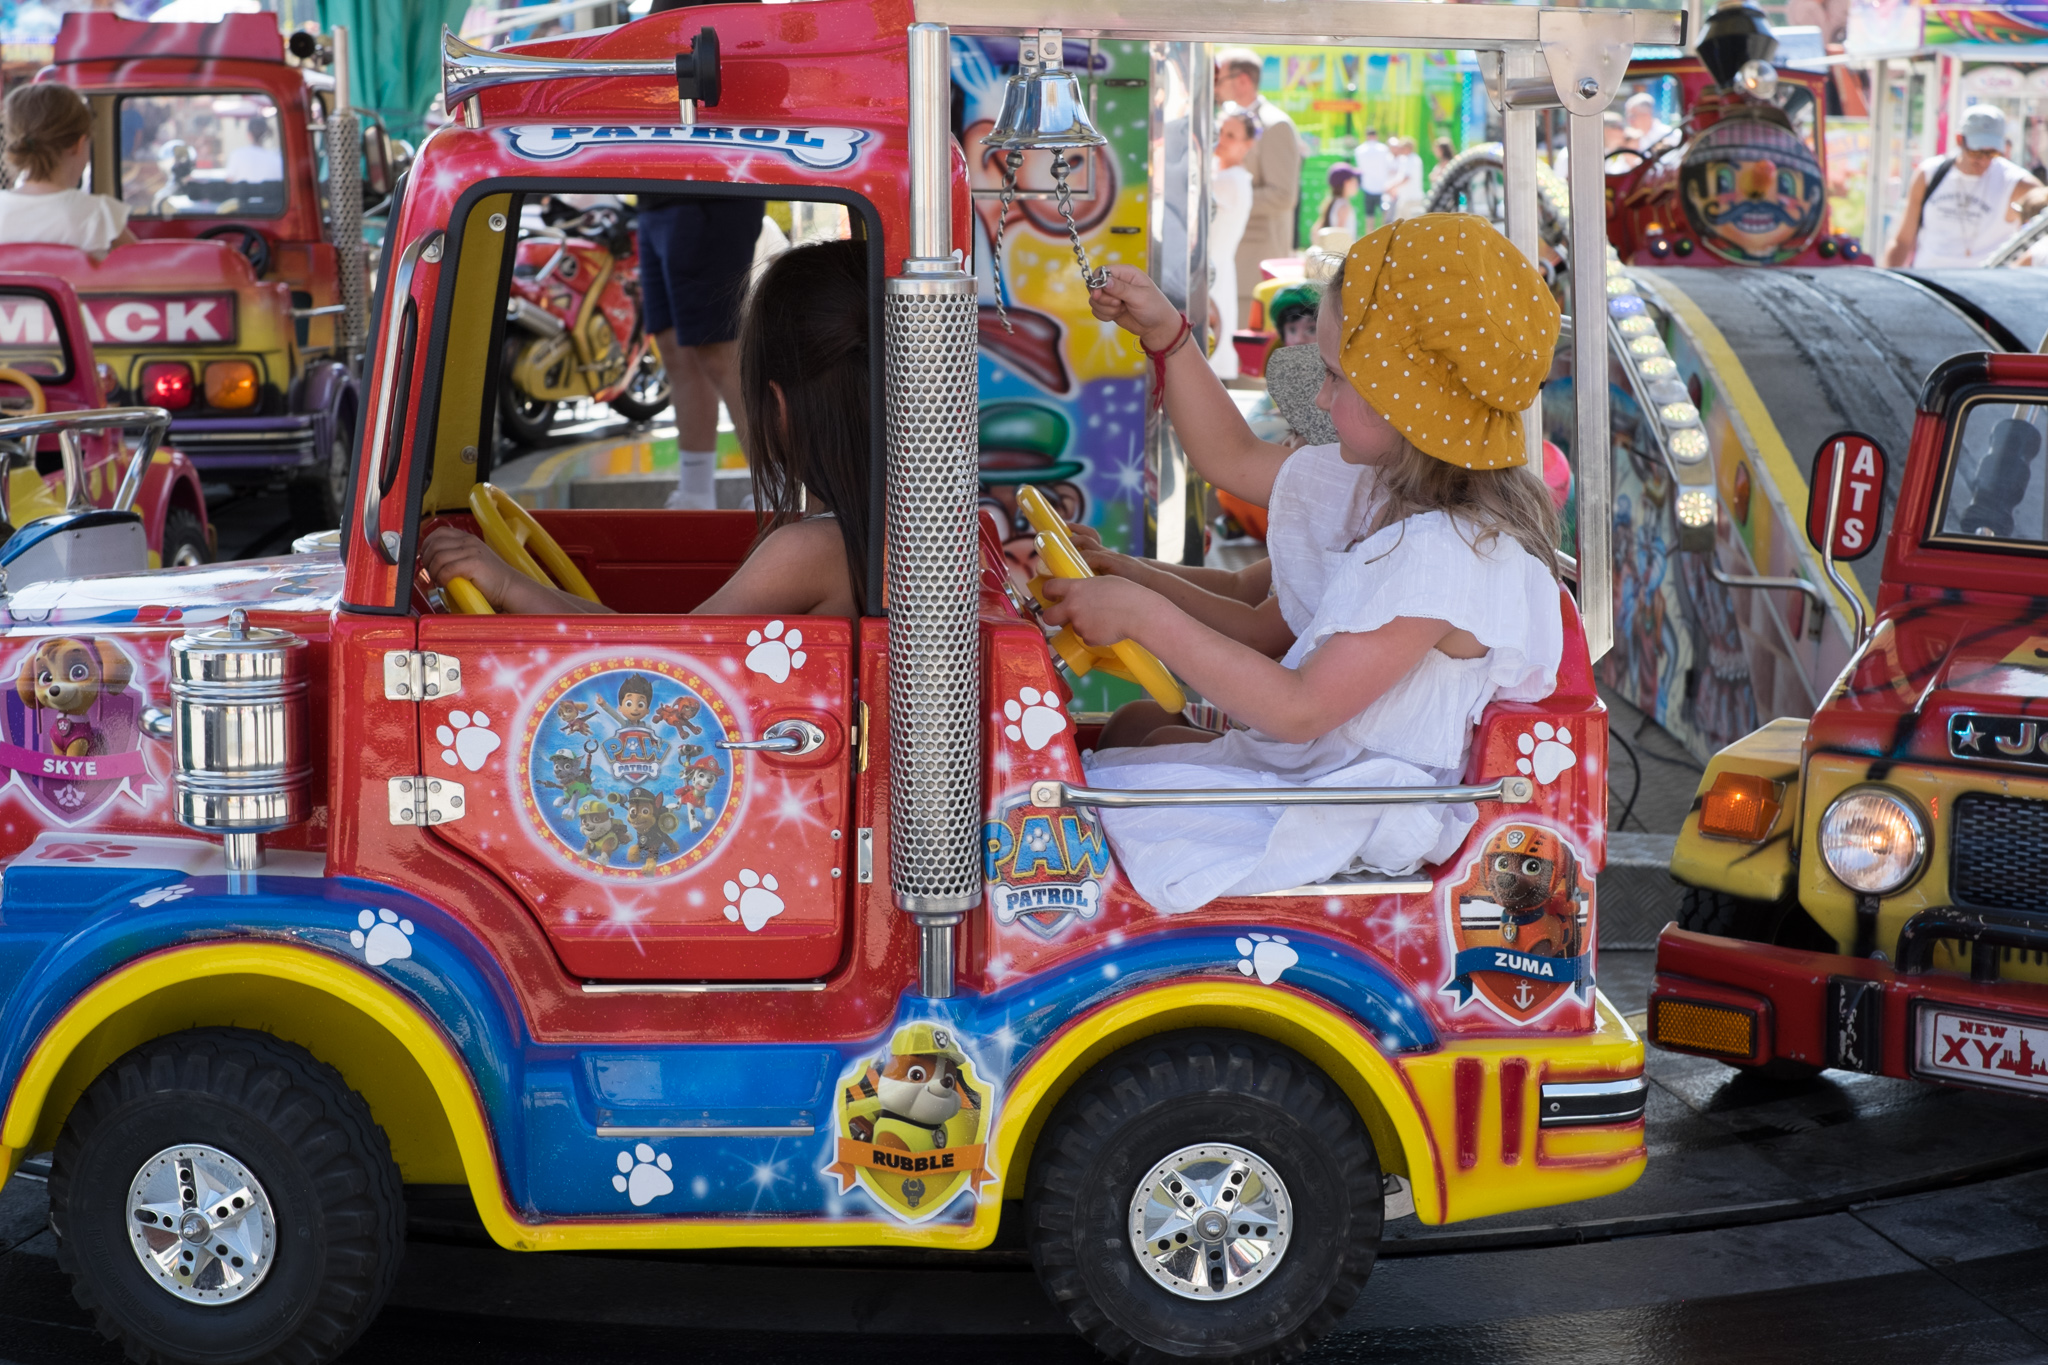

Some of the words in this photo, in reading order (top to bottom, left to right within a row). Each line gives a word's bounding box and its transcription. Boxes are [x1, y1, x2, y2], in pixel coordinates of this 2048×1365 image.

[551, 126, 825, 149] PATROL
[601, 735, 671, 763] PAW
[42, 758, 98, 776] SKYE
[617, 764, 655, 774] PATROL
[981, 814, 1111, 884] PAW
[1006, 887, 1089, 911] PATROL
[1494, 951, 1554, 977] ZUMA
[1958, 1020, 2008, 1039] NEW
[872, 1149, 955, 1172] RUBBLE
